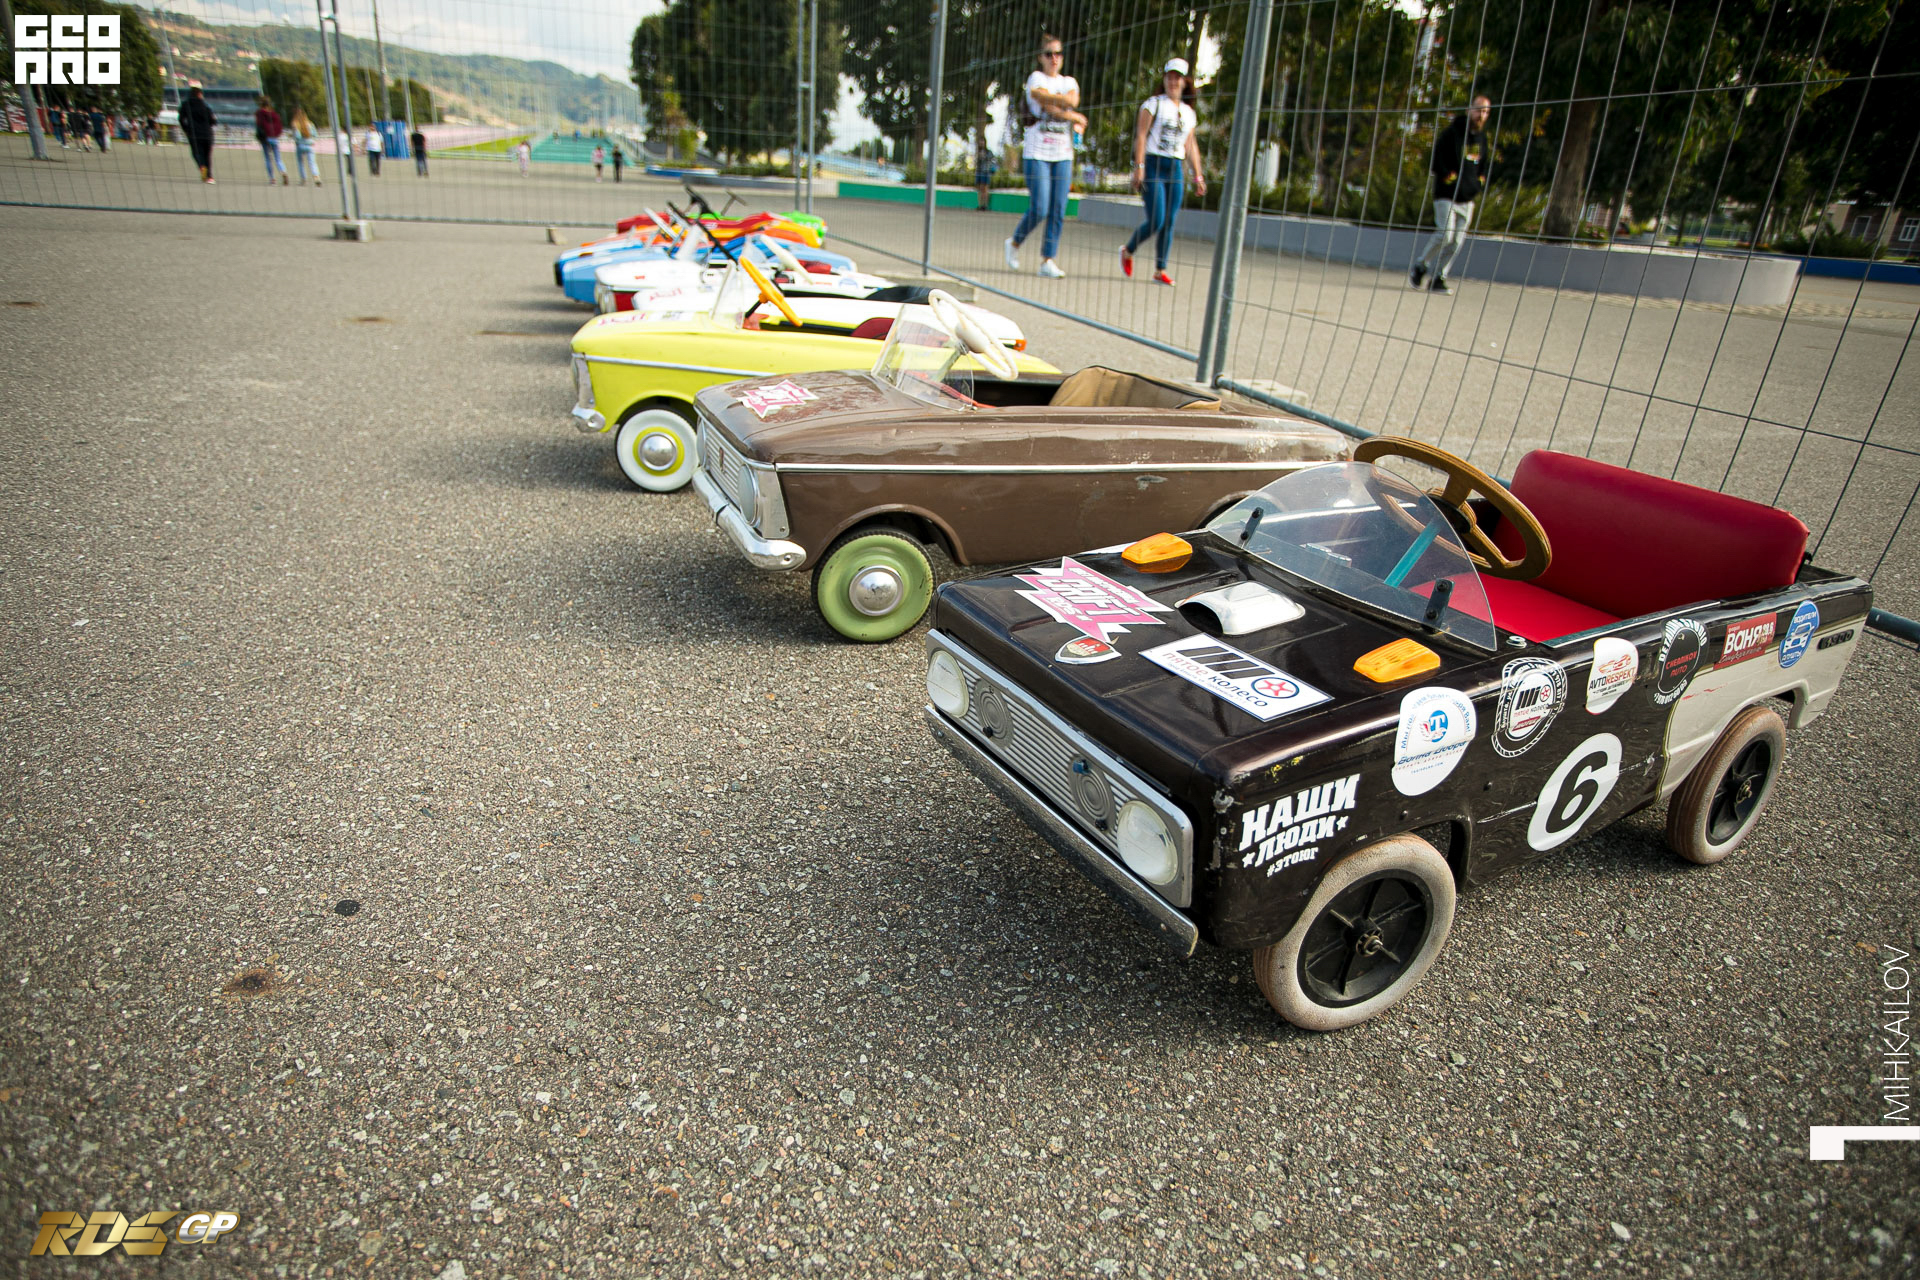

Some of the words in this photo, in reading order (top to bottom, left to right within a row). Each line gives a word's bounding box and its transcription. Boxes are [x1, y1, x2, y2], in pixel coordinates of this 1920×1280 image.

[1679, 618, 1707, 647] STUDIO
[1162, 653, 1208, 677] пятое
[1208, 676, 1268, 707] колесо
[1670, 665, 1688, 678] AUTO
[1433, 740, 1469, 757] Добра
[1239, 773, 1361, 851] НАШИ
[1545, 750, 1608, 834] 6
[1255, 815, 1337, 868] ЛЮДИ
[1266, 846, 1320, 878] #ЭТОЮГ
